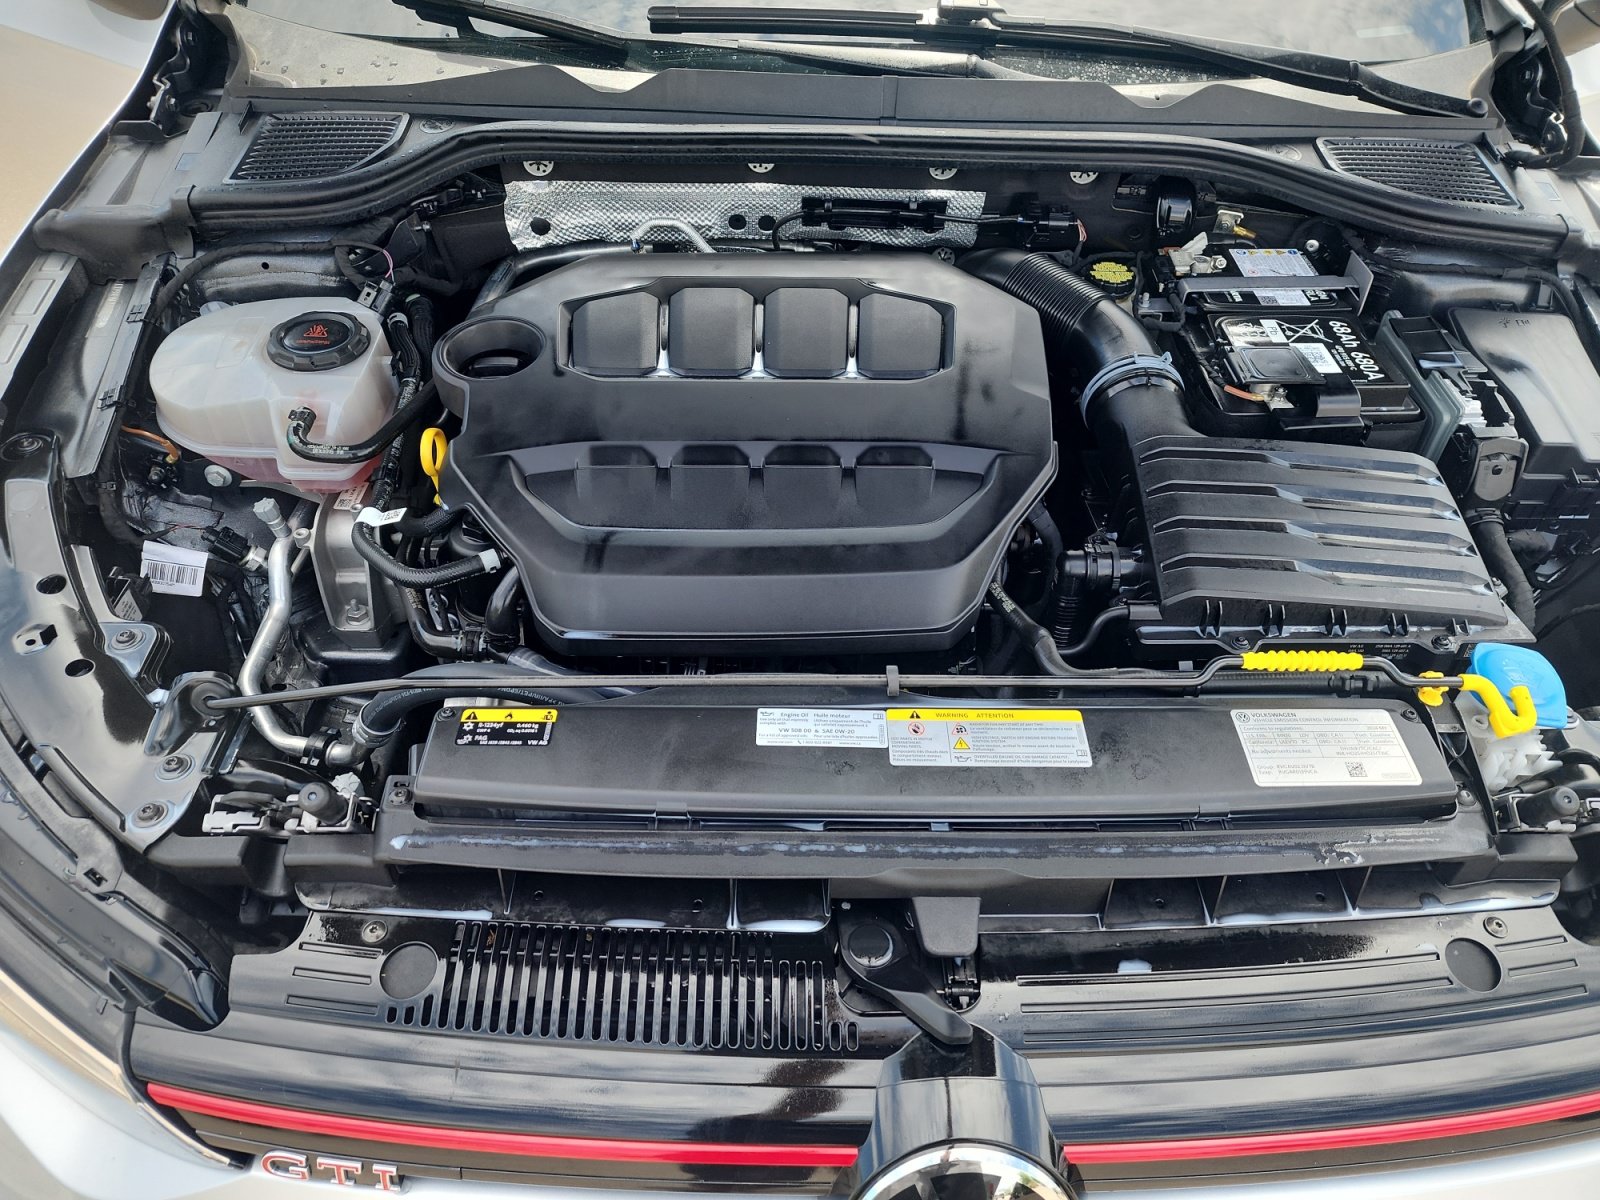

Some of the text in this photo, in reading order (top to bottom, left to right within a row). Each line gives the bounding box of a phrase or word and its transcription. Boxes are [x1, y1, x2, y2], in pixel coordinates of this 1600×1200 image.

[1267, 326, 1277, 336] Pb
[1329, 321, 1360, 347] 68Ah
[1351, 352, 1385, 380] 680A
[261, 1150, 400, 1192] GTI
